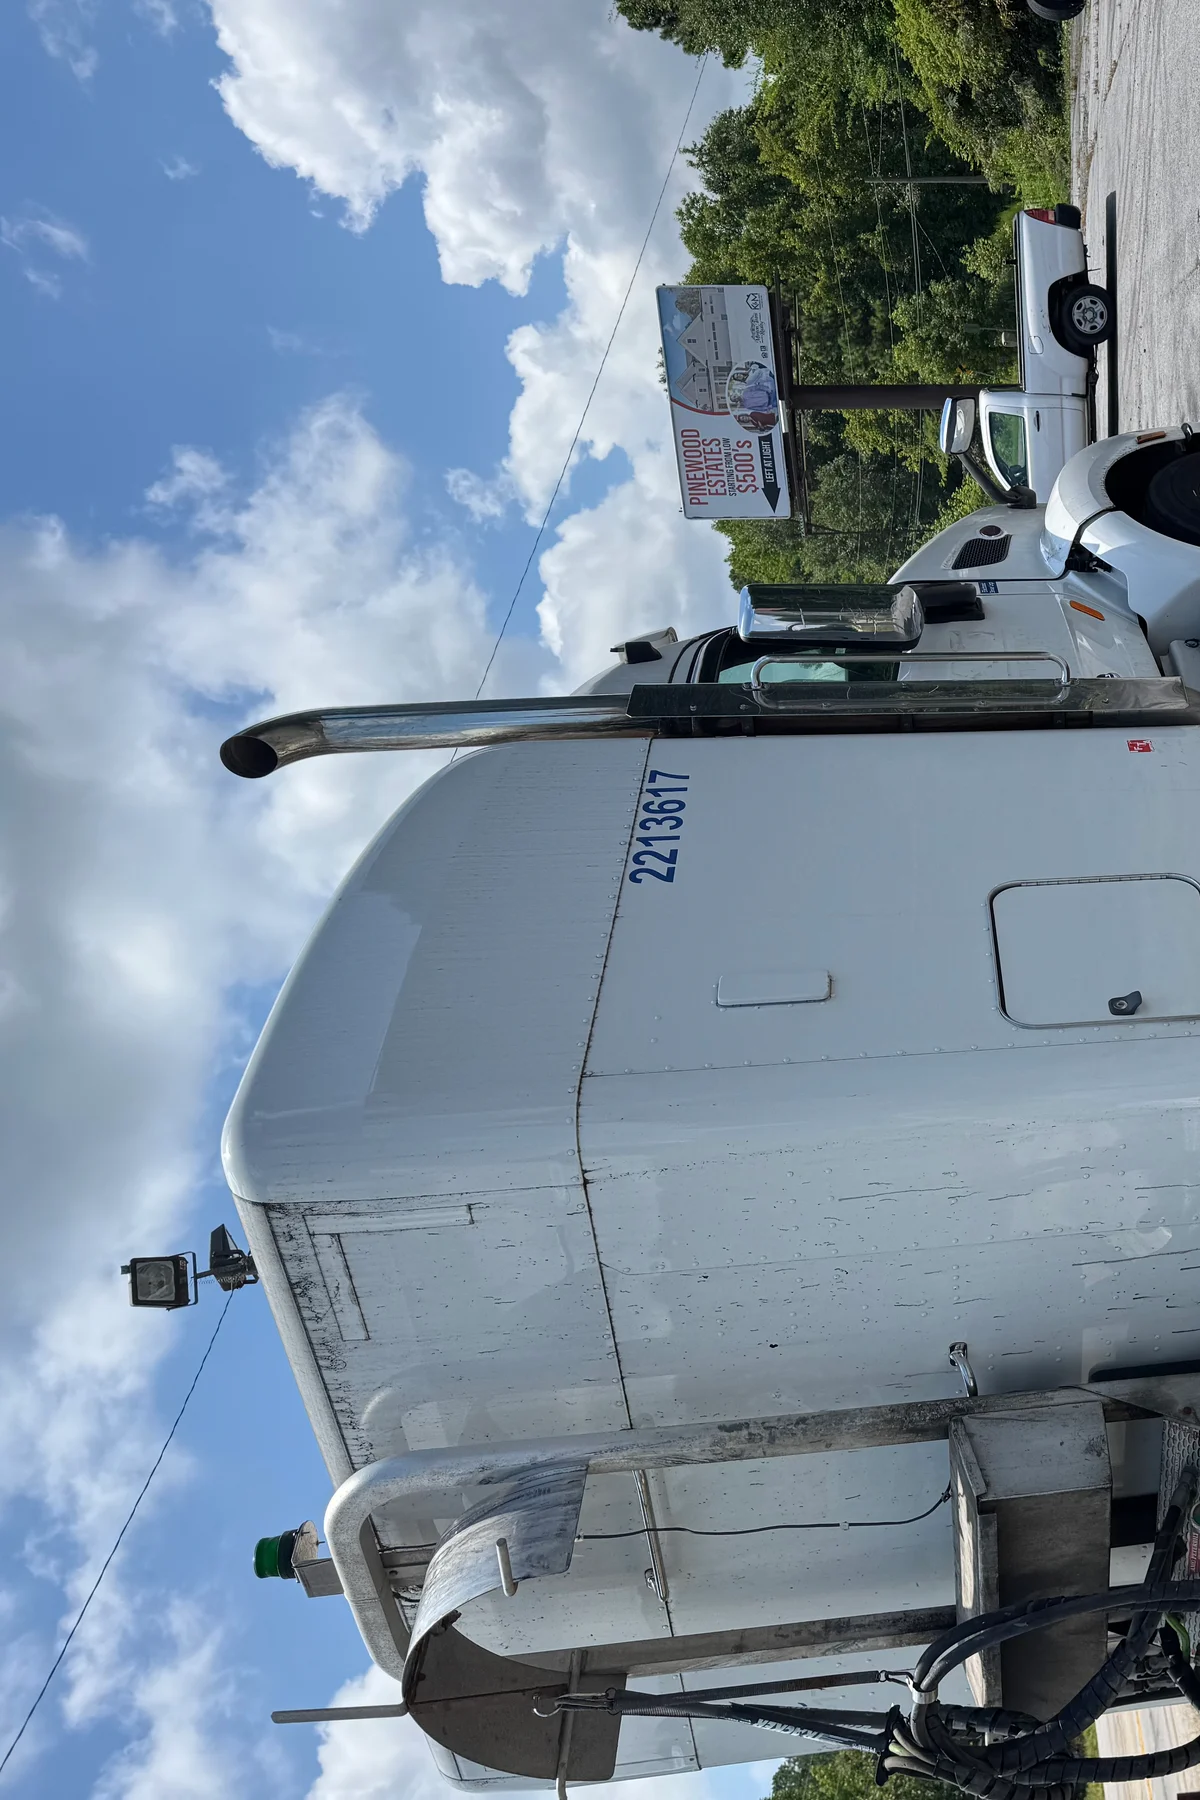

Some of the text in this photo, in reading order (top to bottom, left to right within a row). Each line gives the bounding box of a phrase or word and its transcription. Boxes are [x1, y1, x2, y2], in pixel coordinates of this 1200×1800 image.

[681, 429, 708, 505] PINEWOOD
[702, 438, 727, 496] ESTATES
[722, 438, 737, 496] STARTING FROM LOW
[732, 440, 759, 493] $500's
[762, 441, 774, 482] LEFT AT LIGHT
[628, 769, 691, 884] 2213617
